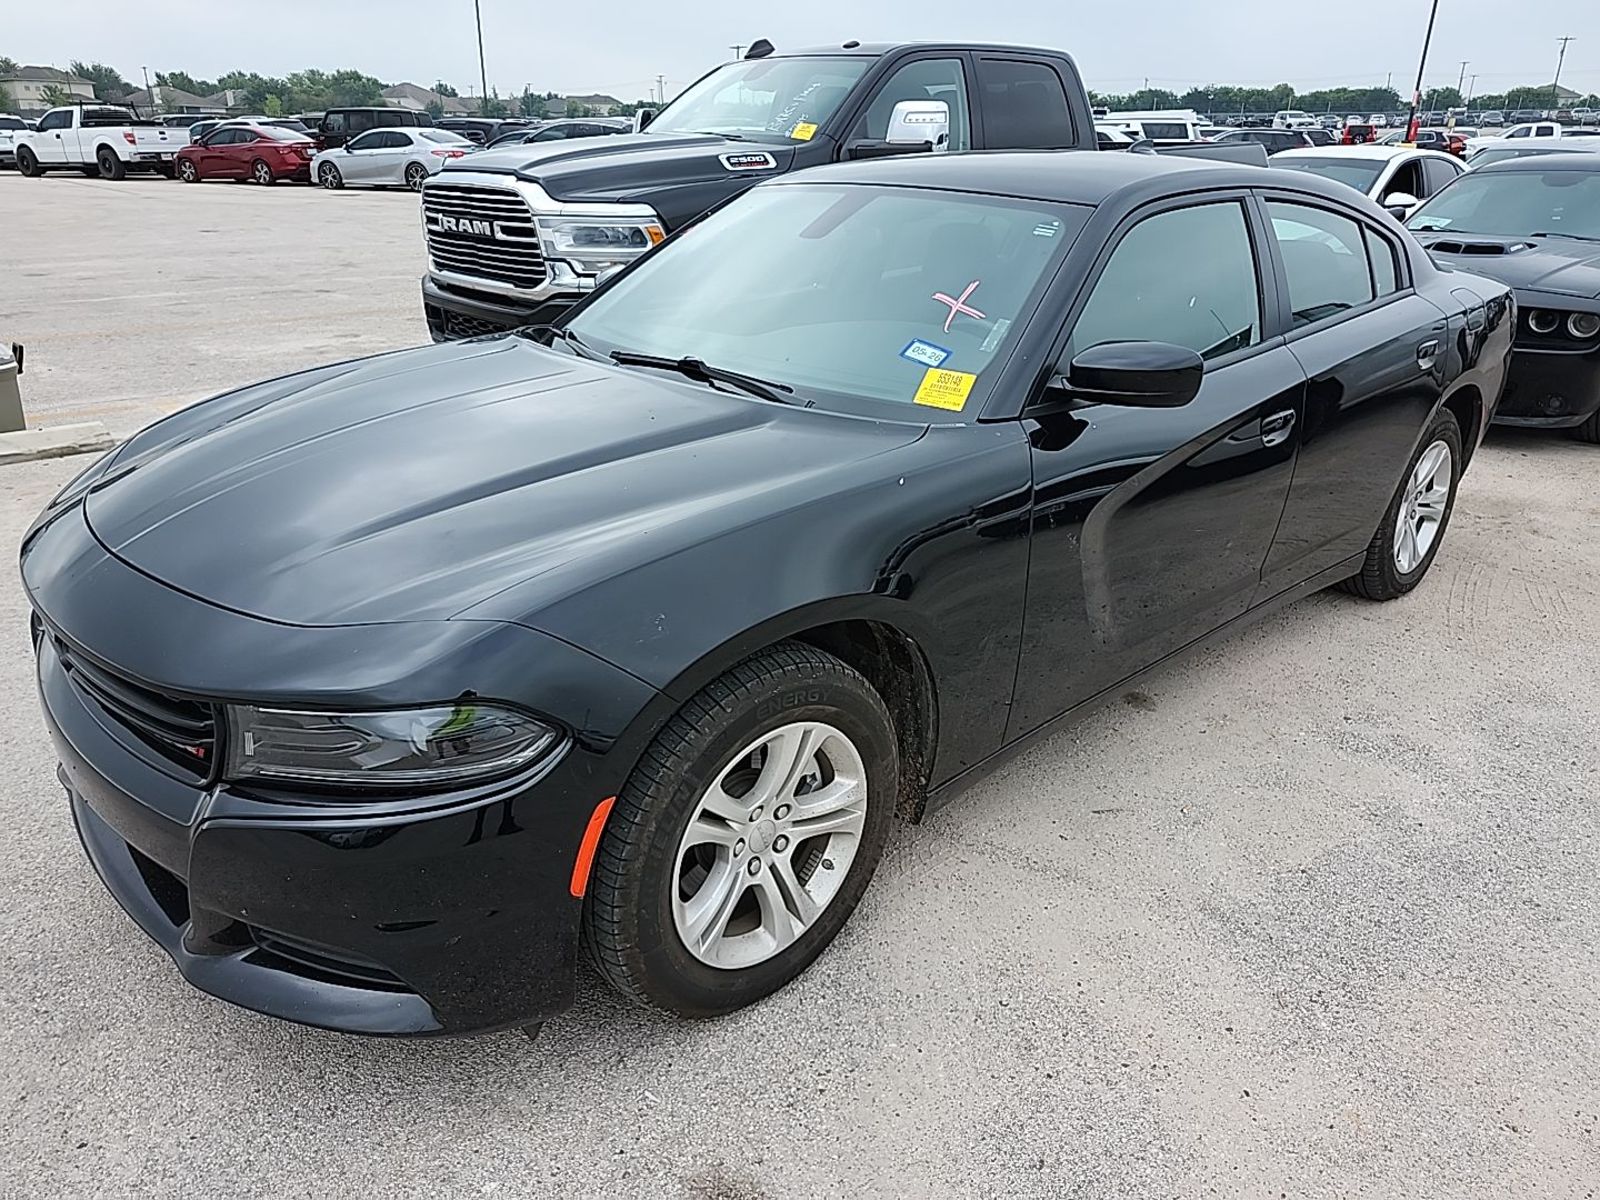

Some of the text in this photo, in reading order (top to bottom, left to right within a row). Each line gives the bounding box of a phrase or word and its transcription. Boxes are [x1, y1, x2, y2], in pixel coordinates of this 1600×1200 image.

[729, 155, 765, 163] 2500
[442, 216, 492, 236] RAM
[757, 687, 833, 719] ENERGY
